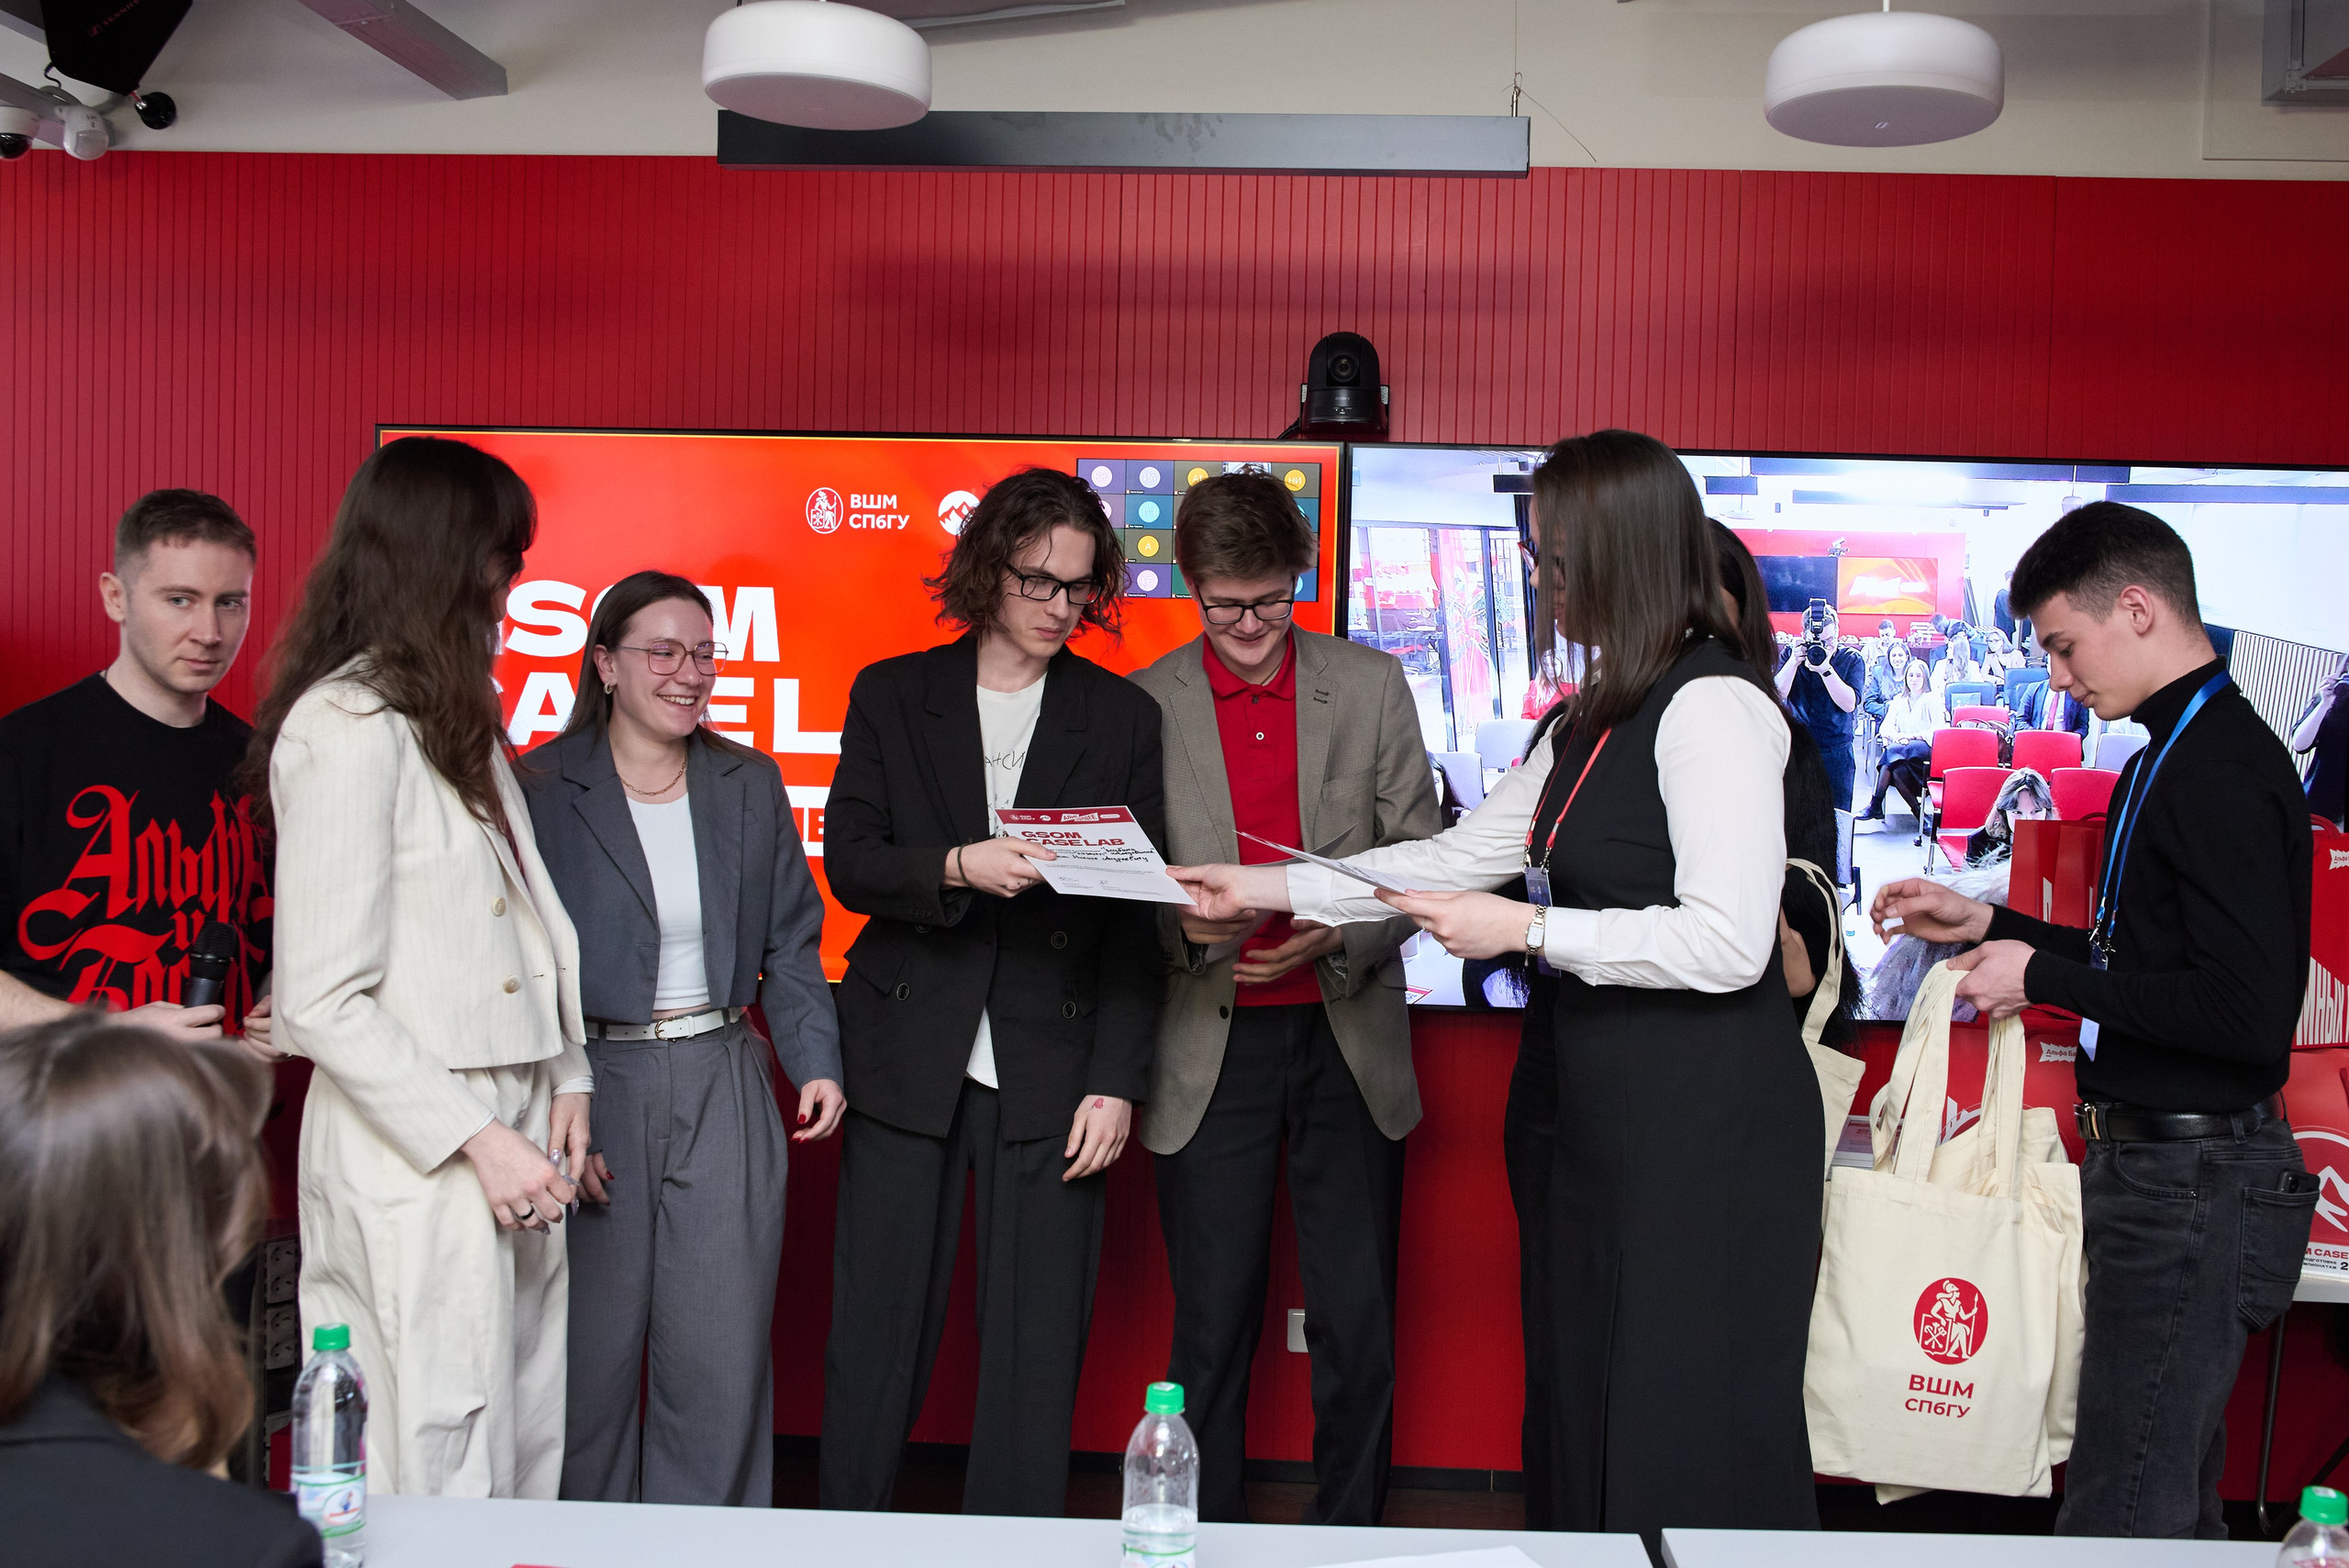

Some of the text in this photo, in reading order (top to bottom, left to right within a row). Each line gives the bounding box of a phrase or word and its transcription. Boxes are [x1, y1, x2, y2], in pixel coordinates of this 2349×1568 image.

[850, 494, 897, 509] ВШМ
[849, 514, 910, 529] СПбГУ
[496, 580, 780, 662] SM
[1021, 830, 1082, 839] GSOM
[1083, 838, 1125, 846] LAB
[2046, 1049, 2067, 1057] Альфа
[2314, 1249, 2349, 1260] CASE
[1909, 1373, 1975, 1399] ВШМ
[1905, 1397, 1971, 1418] СПбГУ
